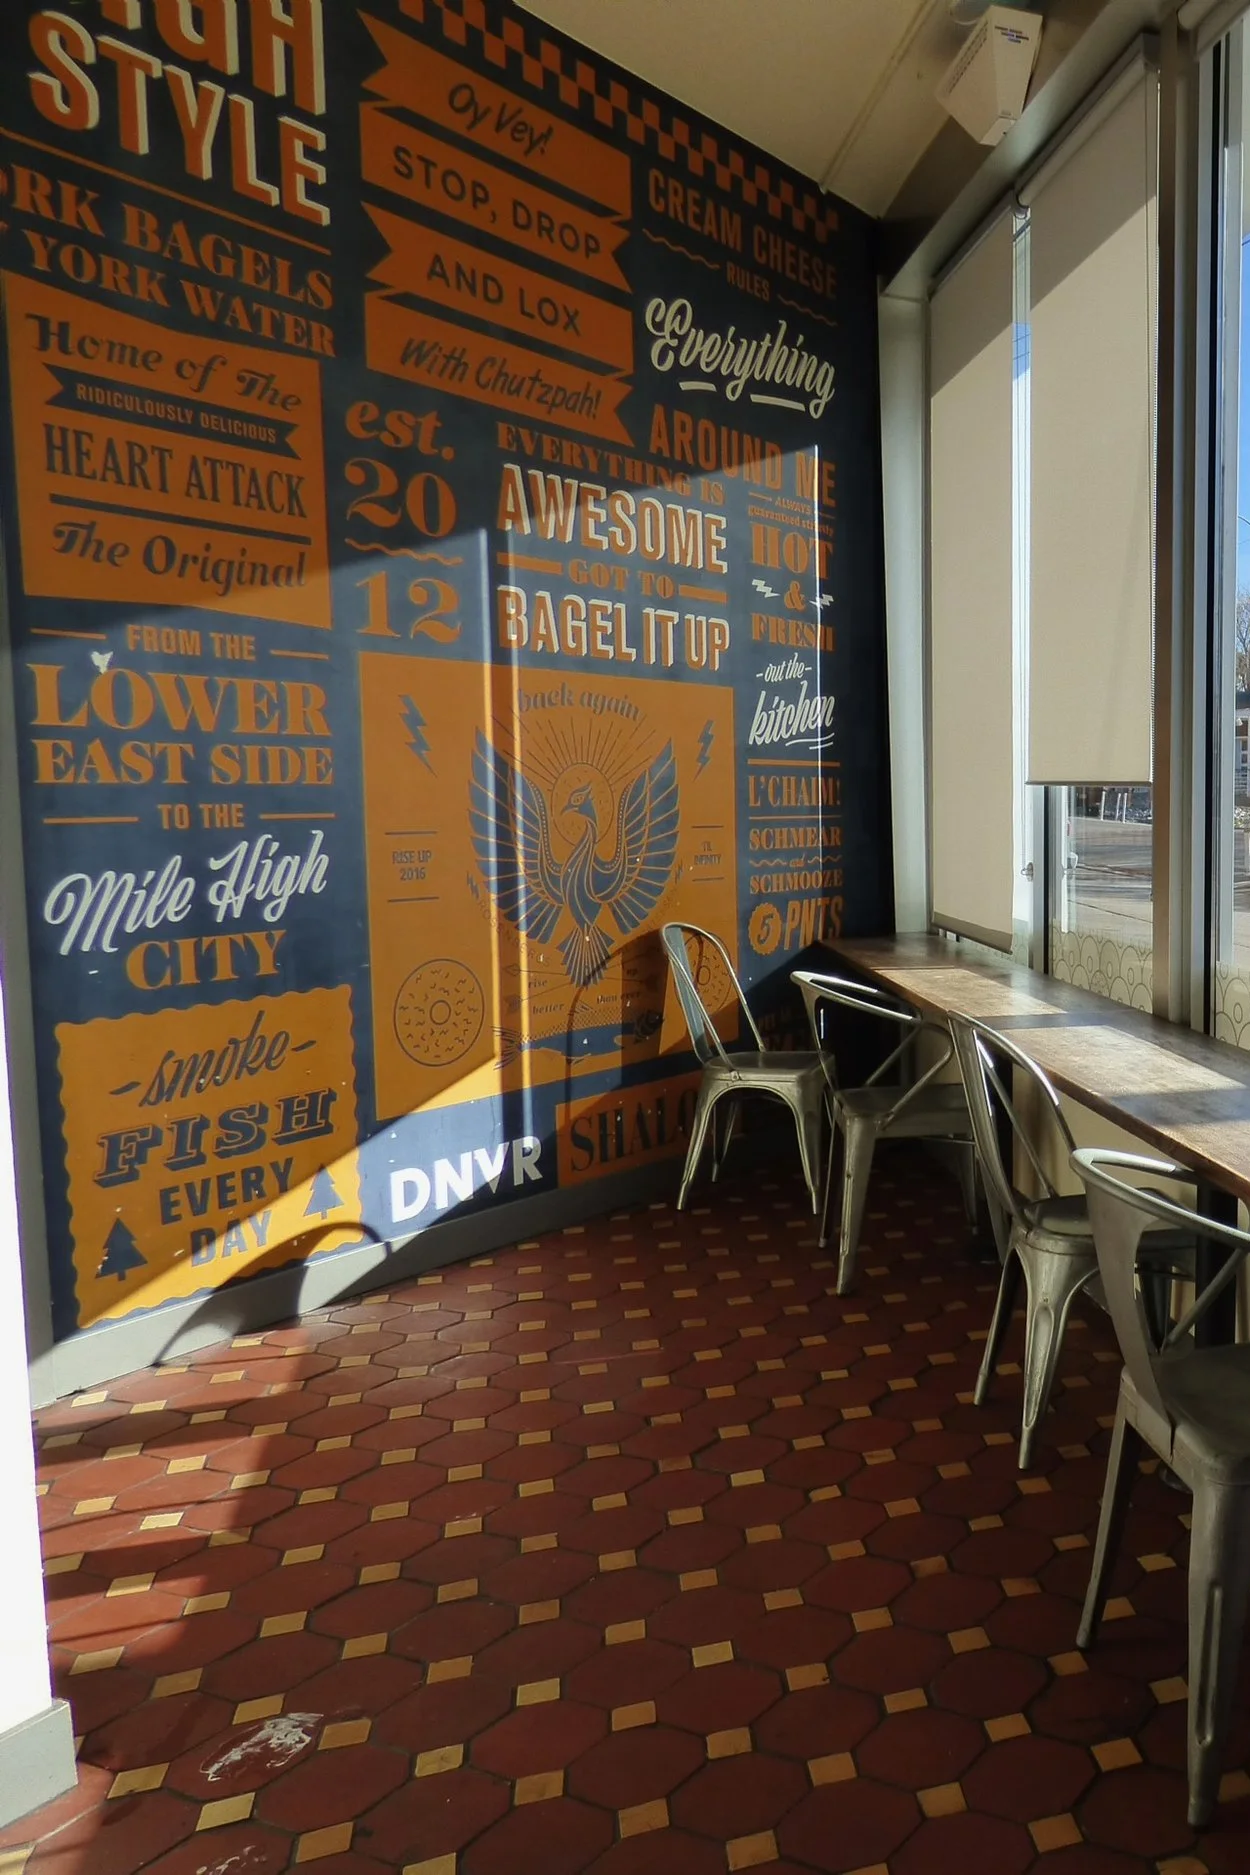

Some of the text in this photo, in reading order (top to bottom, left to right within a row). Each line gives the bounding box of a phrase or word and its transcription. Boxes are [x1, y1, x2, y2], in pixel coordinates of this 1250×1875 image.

[28, 10, 330, 226] STYLE
[448, 83, 554, 155] Oy Vey!
[0, 163, 333, 310] RK BAGELS
[392, 144, 602, 259] STOP, DROP
[649, 168, 837, 300] CREAM CHEESE
[23, 229, 337, 358] YORK WATER
[426, 253, 582, 338] AND LOX
[726, 262, 771, 302] RULES
[25, 312, 302, 412] Home of The
[400, 337, 602, 420] With Chutzpah!
[645, 298, 836, 419] Everything
[76, 383, 278, 445] RIDICULOUSLY DELICIOUS
[345, 401, 456, 461] est.
[43, 422, 307, 519] HEART ATTACK
[497, 421, 726, 507] EVERYTHING IS
[650, 403, 837, 508] AROUND ME
[343, 457, 458, 539] 20
[496, 462, 730, 575] AWESOME
[52, 521, 307, 597] The Original
[568, 558, 675, 599] GOT TO
[751, 523, 835, 580] HOT
[355, 570, 462, 645] 12
[496, 584, 731, 672] BAGEL IT UP
[751, 613, 835, 652] FRESH
[784, 581, 806, 612] &
[126, 624, 256, 660] FROM THE
[786, 652, 804, 680] the
[26, 663, 332, 736] LOWER
[518, 682, 642, 721] back again
[749, 681, 836, 746] kitchen
[31, 737, 334, 785] EAST SIDE
[749, 775, 840, 807] L'CHAIM!
[157, 803, 245, 829] TO THE
[749, 826, 841, 850] SCHMEAR
[44, 830, 330, 956] Mile High
[392, 850, 432, 864] RISE UP
[749, 868, 843, 895] SCHMOOZE
[126, 929, 286, 990] CITY
[759, 896, 843, 951] 5 PNTS
[528, 980, 548, 989] rise
[532, 1002, 565, 1015] better
[139, 1010, 290, 1107] smoke
[93, 1087, 337, 1188] FISH
[570, 1088, 700, 1173] SHALO
[159, 1157, 294, 1226] EVERY
[390, 1135, 543, 1224] DNVR
[190, 1210, 272, 1268] DAY
